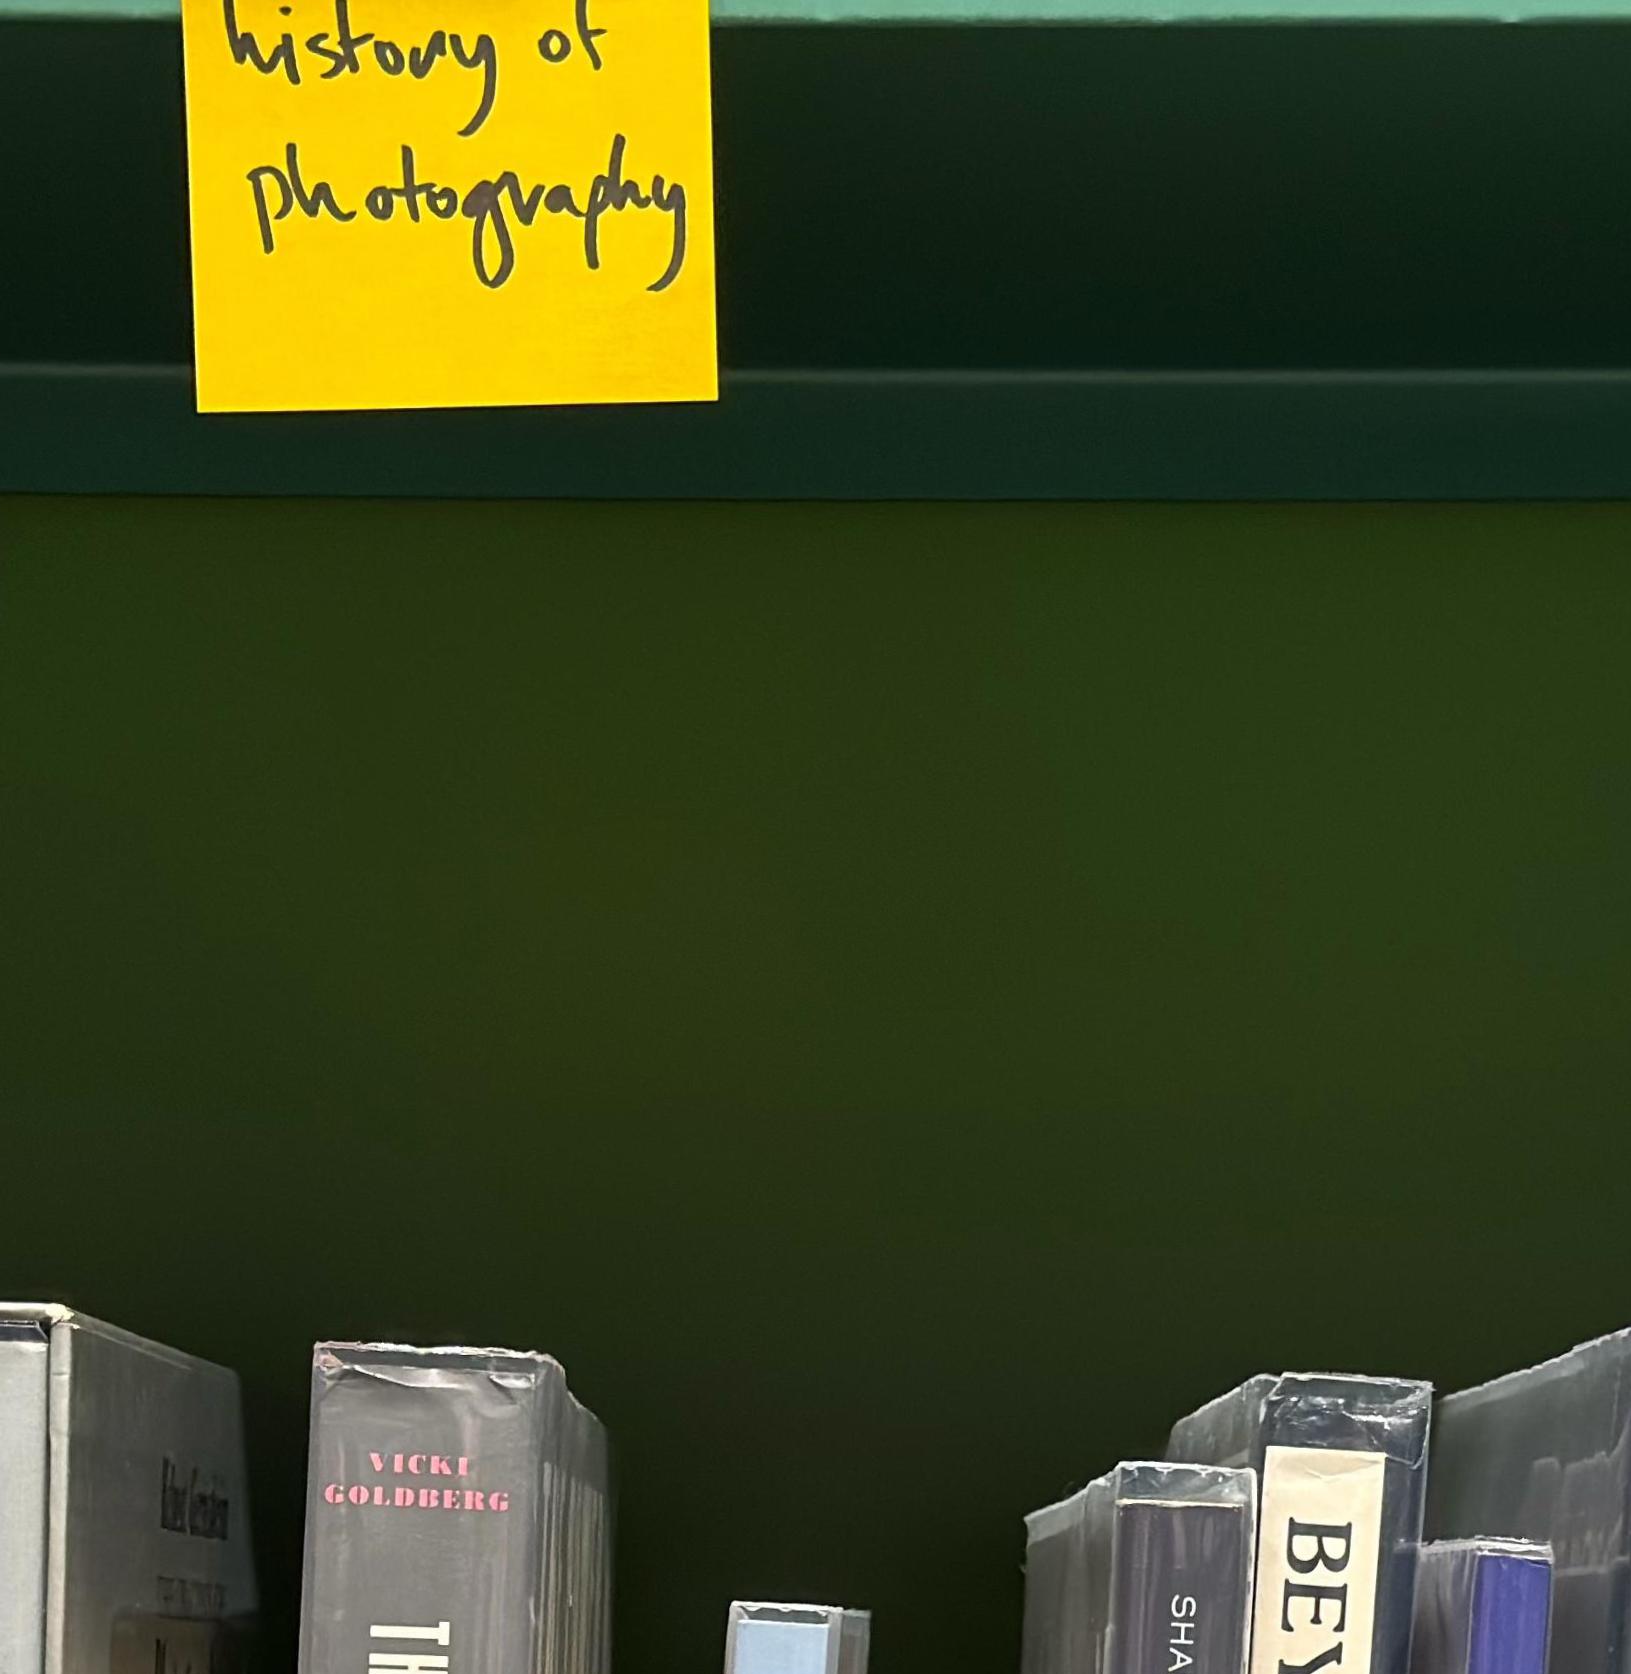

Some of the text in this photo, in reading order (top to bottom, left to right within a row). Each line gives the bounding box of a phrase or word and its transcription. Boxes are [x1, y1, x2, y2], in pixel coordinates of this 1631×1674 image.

[224, 0, 607, 136] history of
[247, 134, 687, 292] photography
[324, 1483, 510, 1512] GOLDBERG
[369, 1452, 470, 1478] VICKI
